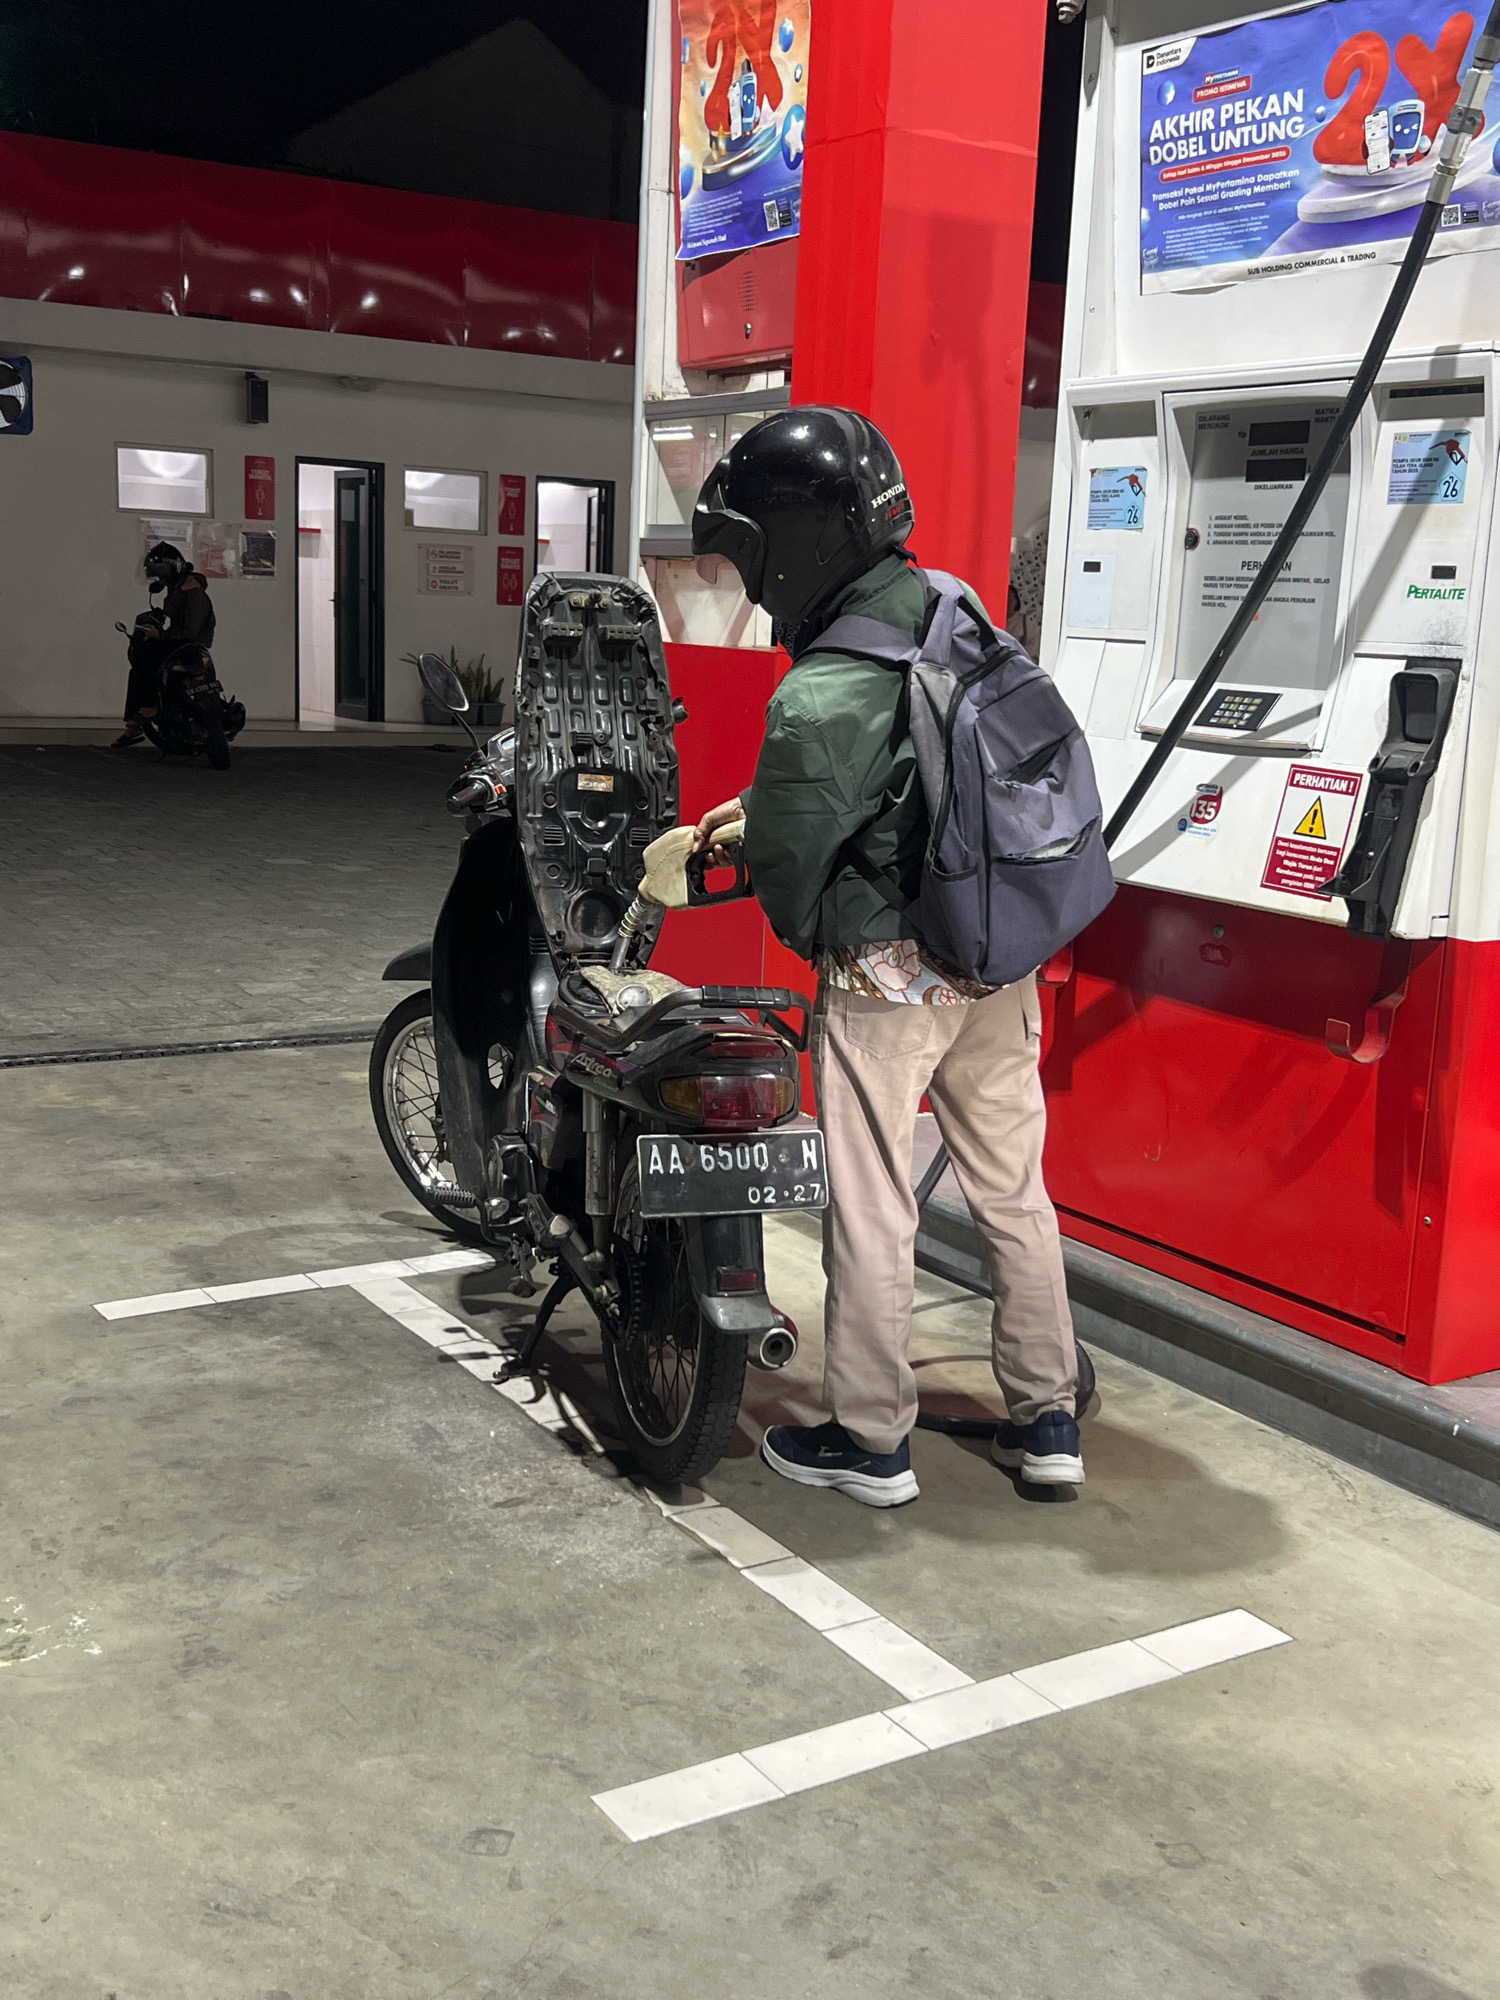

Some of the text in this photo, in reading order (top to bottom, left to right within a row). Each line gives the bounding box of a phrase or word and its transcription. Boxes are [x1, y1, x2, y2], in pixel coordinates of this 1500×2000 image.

[1156, 47, 1182, 59] Danantara
[1156, 55, 1180, 66] Indonesia
[1196, 80, 1247, 98] PROMO ISTIMEWA
[1150, 88, 1304, 144] AKHIR PEKAN
[1150, 116, 1305, 166] DOBEL UNTUNG
[1152, 169, 1300, 202] Transaksi Pakai MyPertamina Dapatkan
[1158, 180, 1291, 211] Dobel Poin Sesuai Grading Member!
[1247, 252, 1376, 276] SUB HOLDING COMMERCIAL & TRADING
[1198, 414, 1230, 422] DILARANG
[1198, 422, 1229, 430] MEROKOK
[1238, 431, 1247, 440] Rp
[1250, 448, 1304, 456] JUMLAH HARGA
[871, 482, 906, 508] HONDA
[1443, 480, 1458, 498] 26
[1127, 508, 1138, 524] 26
[1406, 584, 1466, 600] PERTALITE
[1293, 772, 1348, 792] PERHATIAN
[1191, 799, 1218, 820] 135
[650, 1138, 818, 1175] AA 6500 N
